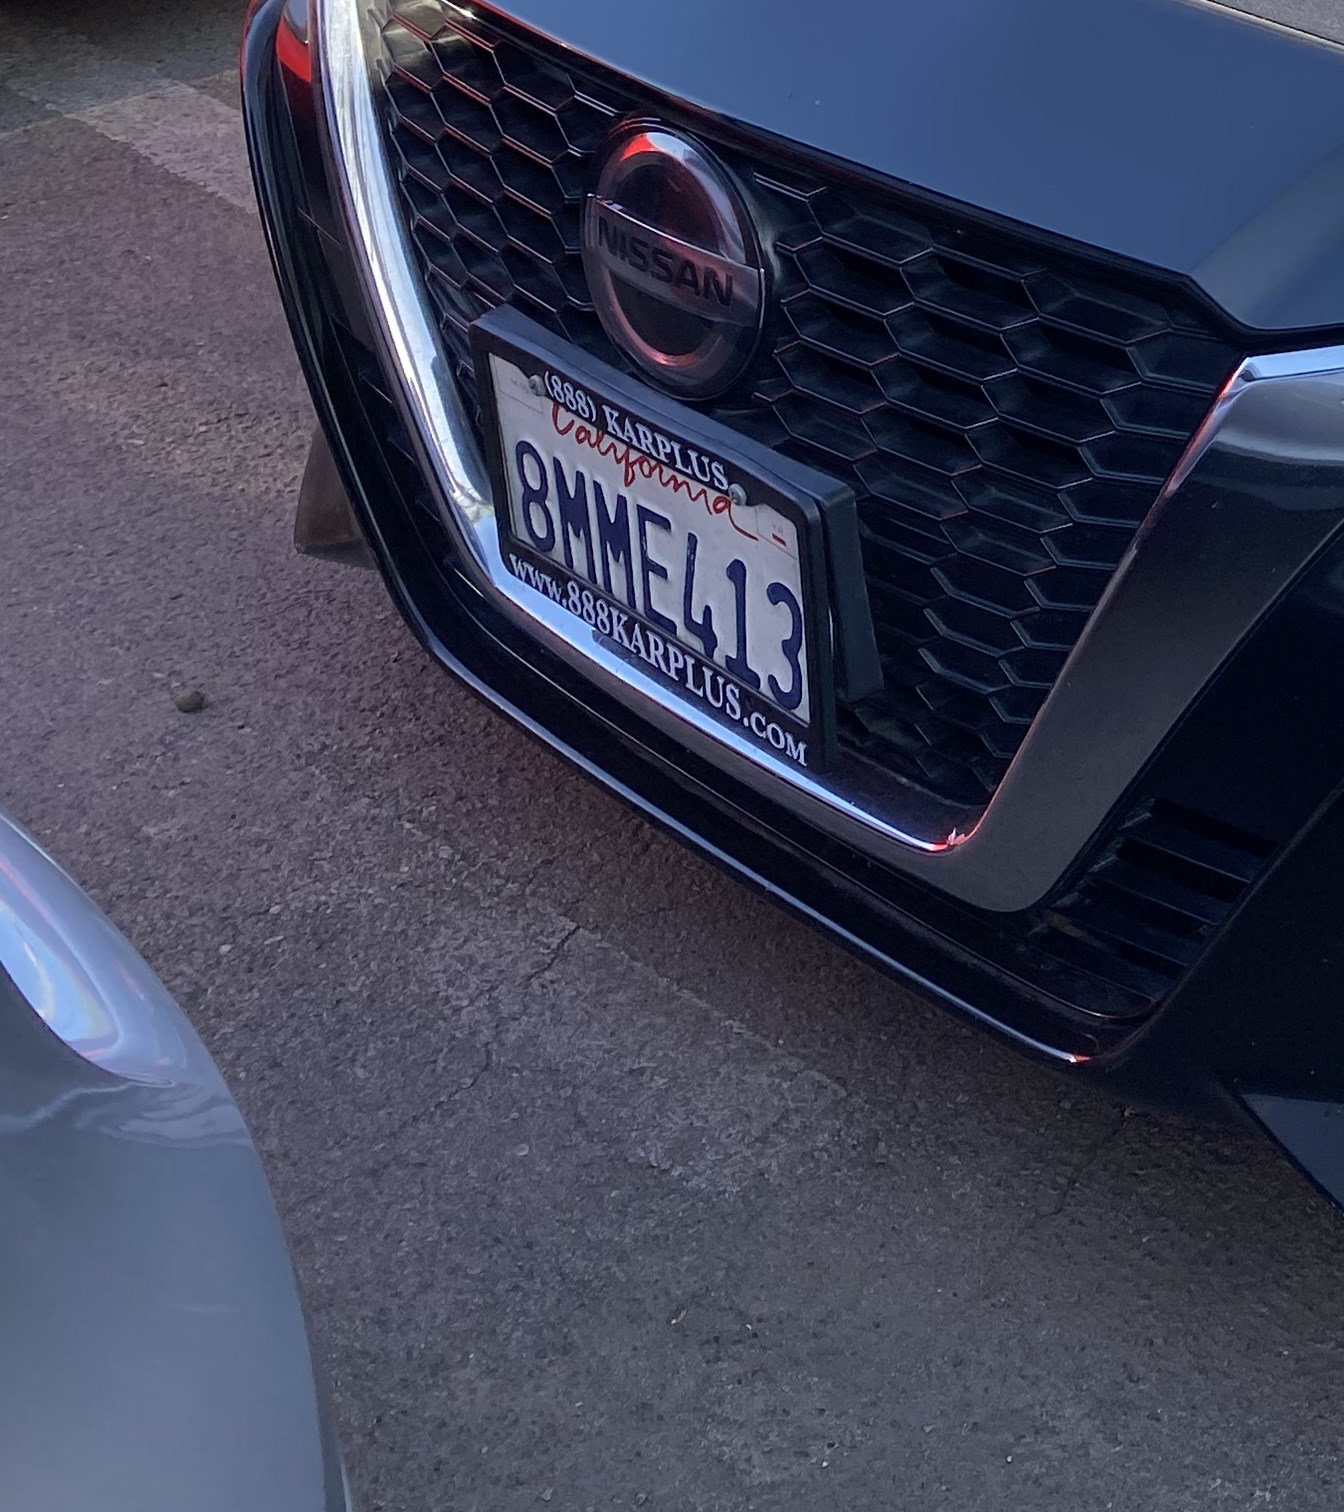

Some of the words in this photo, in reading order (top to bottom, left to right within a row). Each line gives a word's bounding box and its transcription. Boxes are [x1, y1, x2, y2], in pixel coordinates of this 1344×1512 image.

[600, 217, 734, 306] NISSAN
[545, 371, 597, 422] (888)
[602, 404, 730, 490] KARPLUS
[552, 402, 758, 541] California
[514, 440, 803, 710] 8MME413
